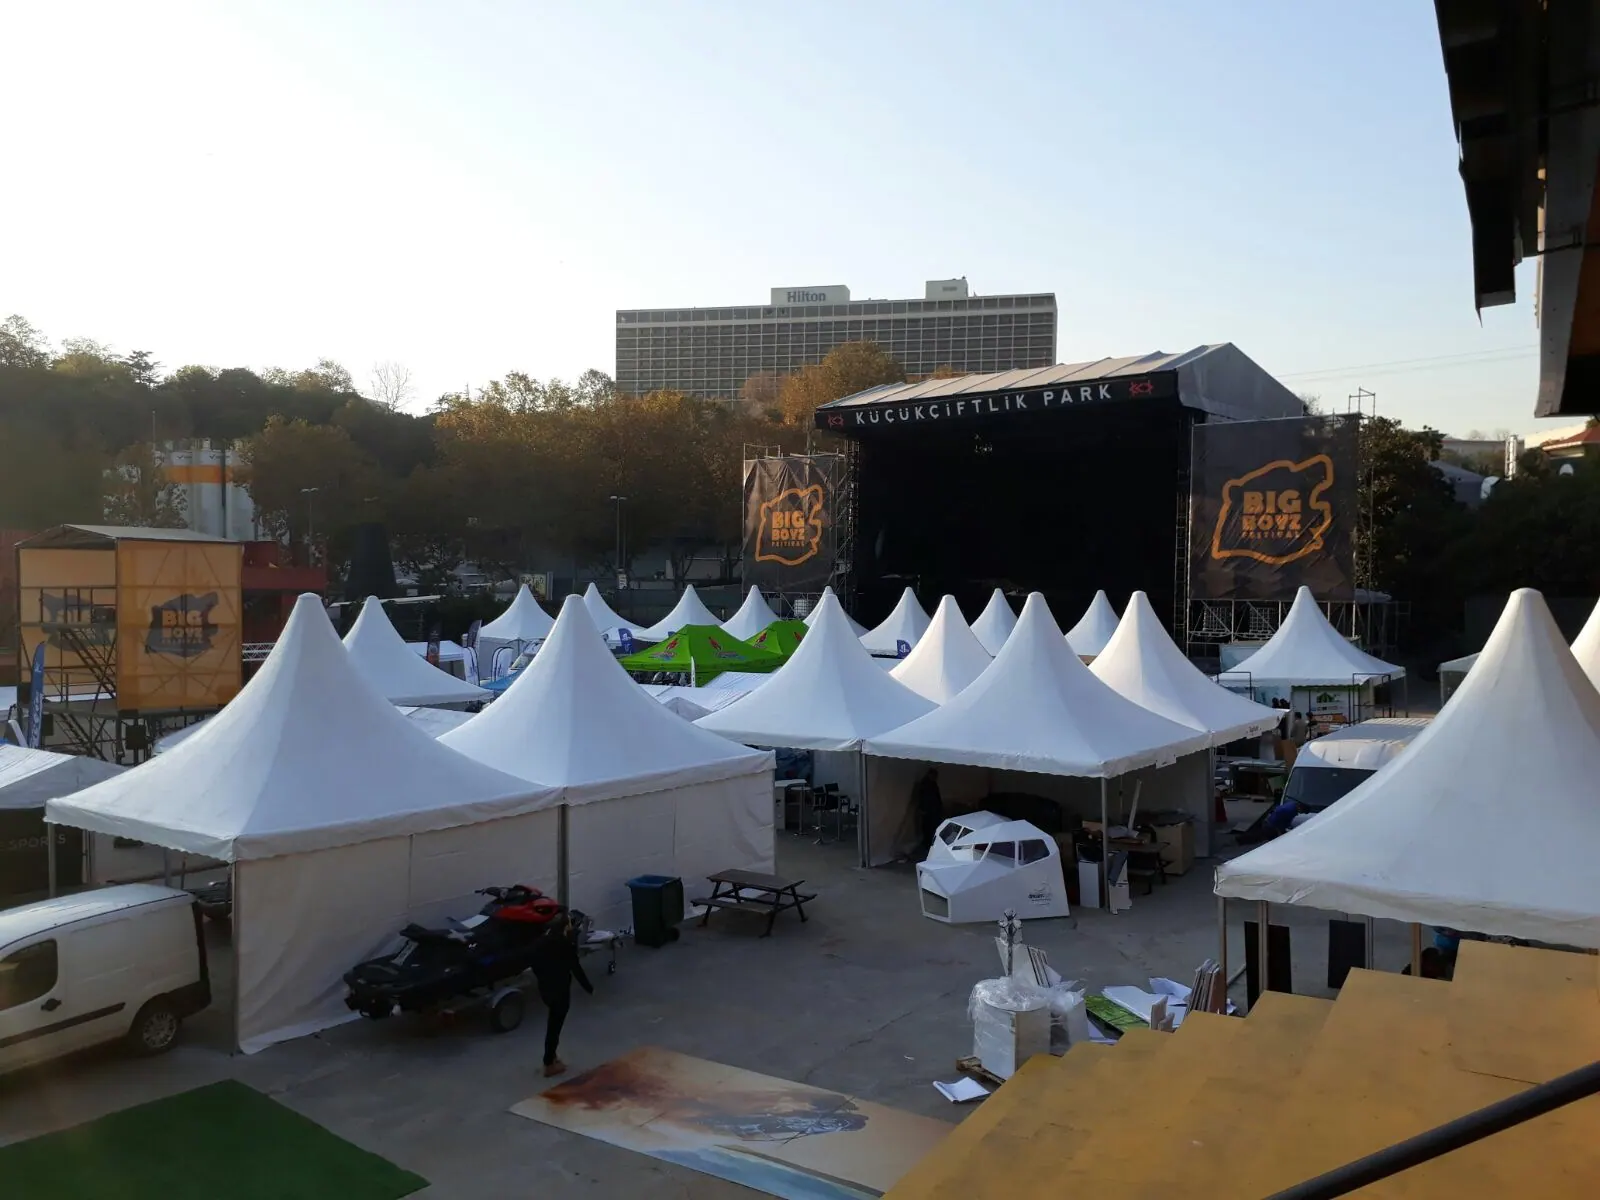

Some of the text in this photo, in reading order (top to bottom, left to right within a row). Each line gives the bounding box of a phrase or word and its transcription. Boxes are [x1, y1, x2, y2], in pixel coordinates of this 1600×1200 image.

[787, 290, 827, 303] Hilton
[1043, 383, 1112, 406] PARK
[1243, 490, 1301, 514] BIG
[772, 511, 804, 529] BIG
[1242, 514, 1301, 531] BOYZ
[772, 529, 805, 541] BOYZ
[163, 610, 202, 627] BIG
